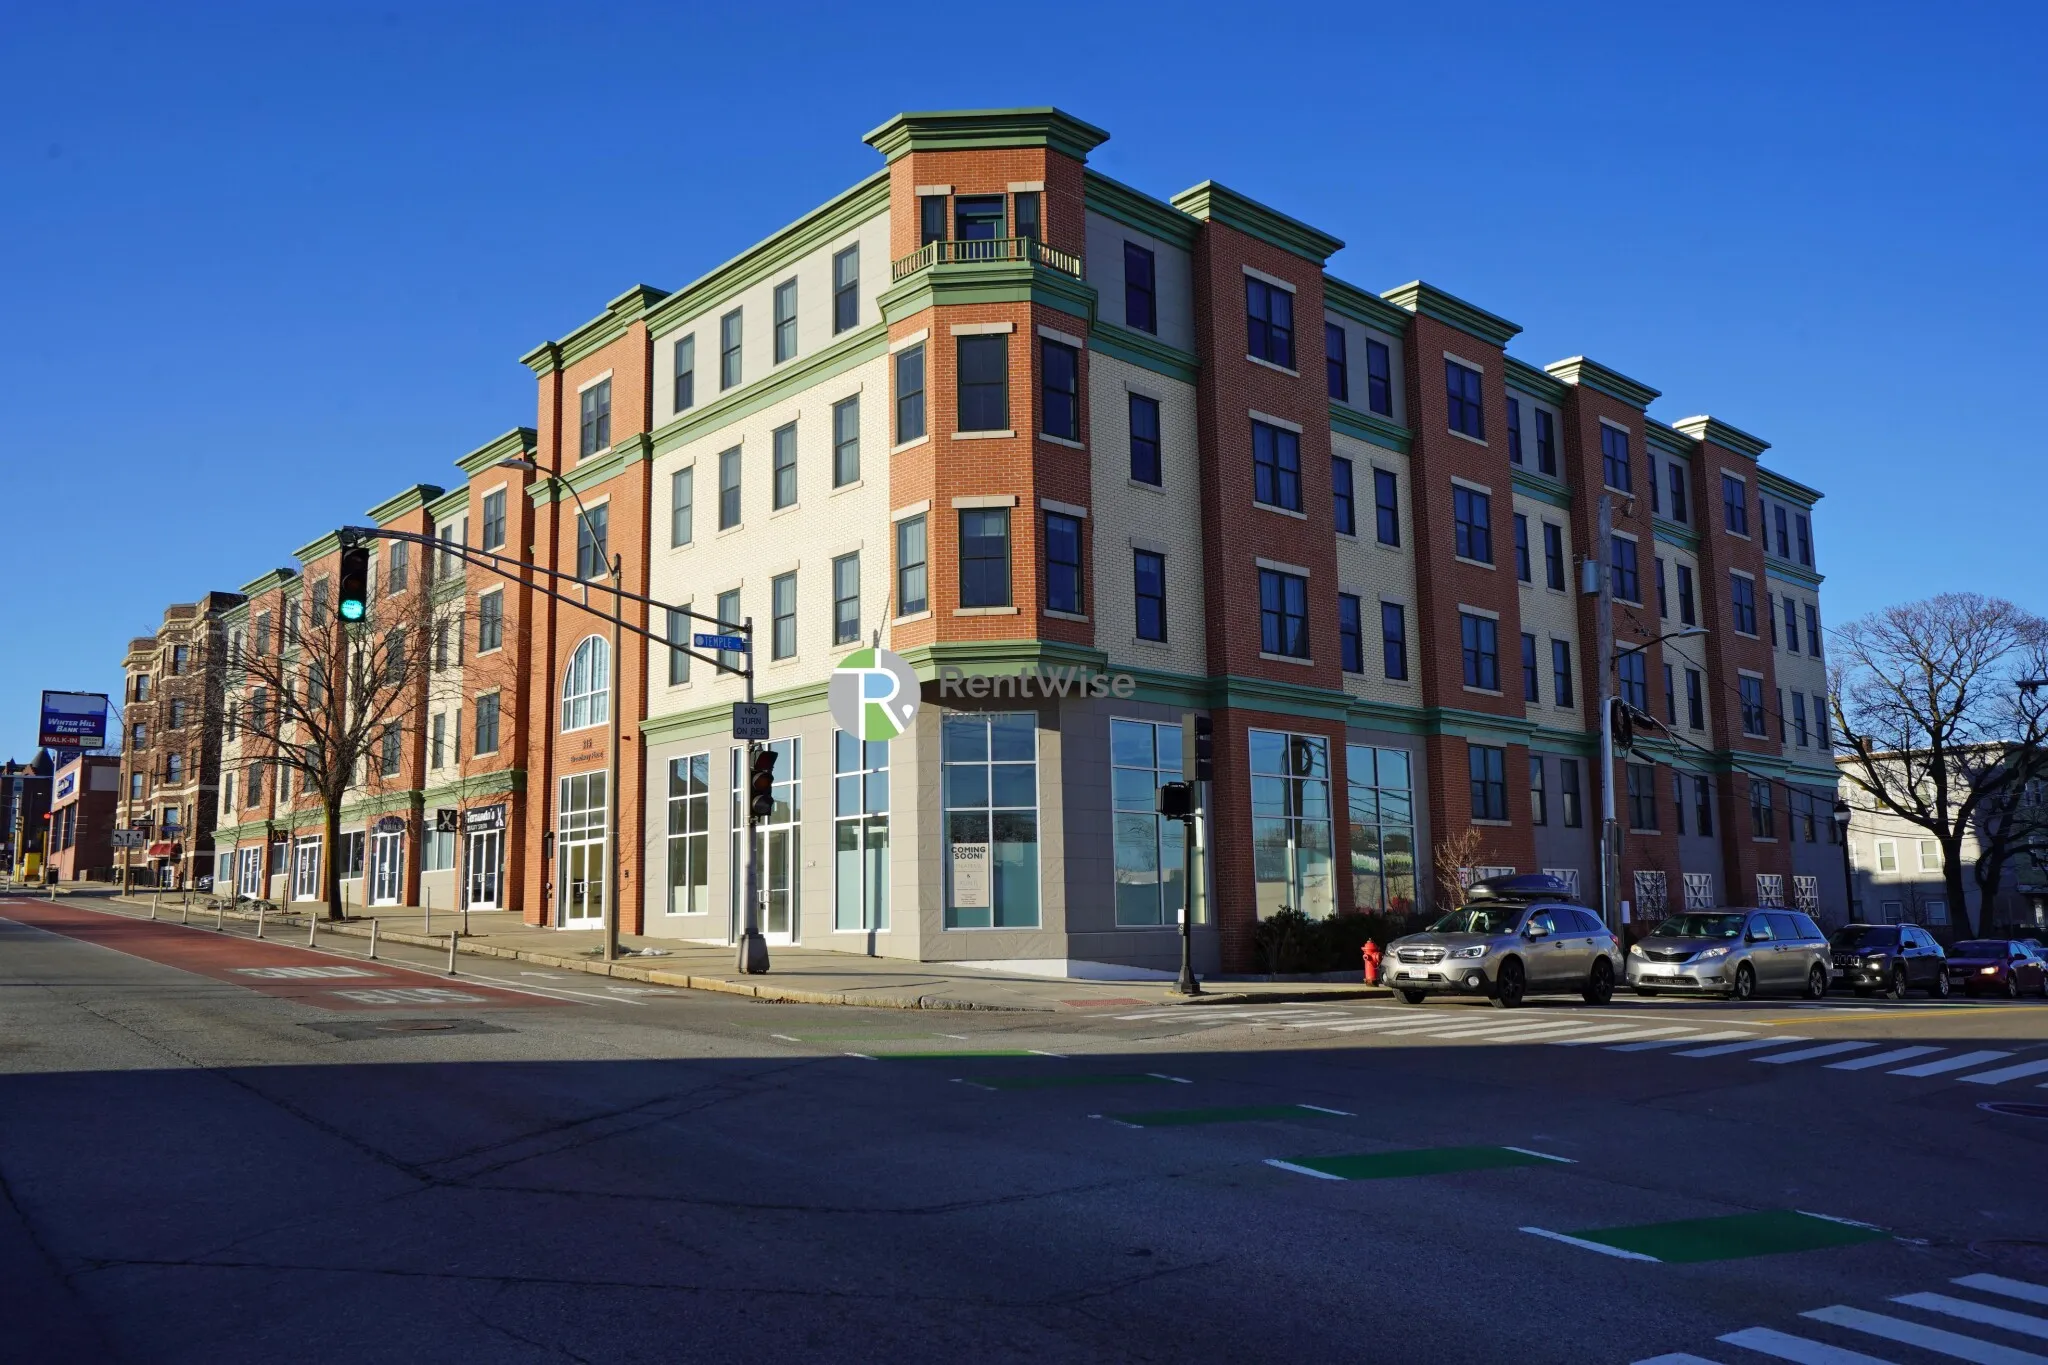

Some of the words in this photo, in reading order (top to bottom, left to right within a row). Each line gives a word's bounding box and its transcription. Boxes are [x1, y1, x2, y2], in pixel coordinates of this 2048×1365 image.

[705, 636, 732, 648] TEMPLE
[744, 707, 758, 715] NO
[48, 718, 79, 726] WINTER
[79, 719, 96, 727] HILL
[741, 717, 761, 725] TURN
[56, 725, 79, 733] BANK
[736, 727, 748, 735] ON
[750, 727, 766, 735] RED
[44, 736, 78, 744] WALK-IN
[383, 823, 403, 831] NAILS
[951, 846, 986, 854] COMING
[330, 988, 488, 1004] BUS
